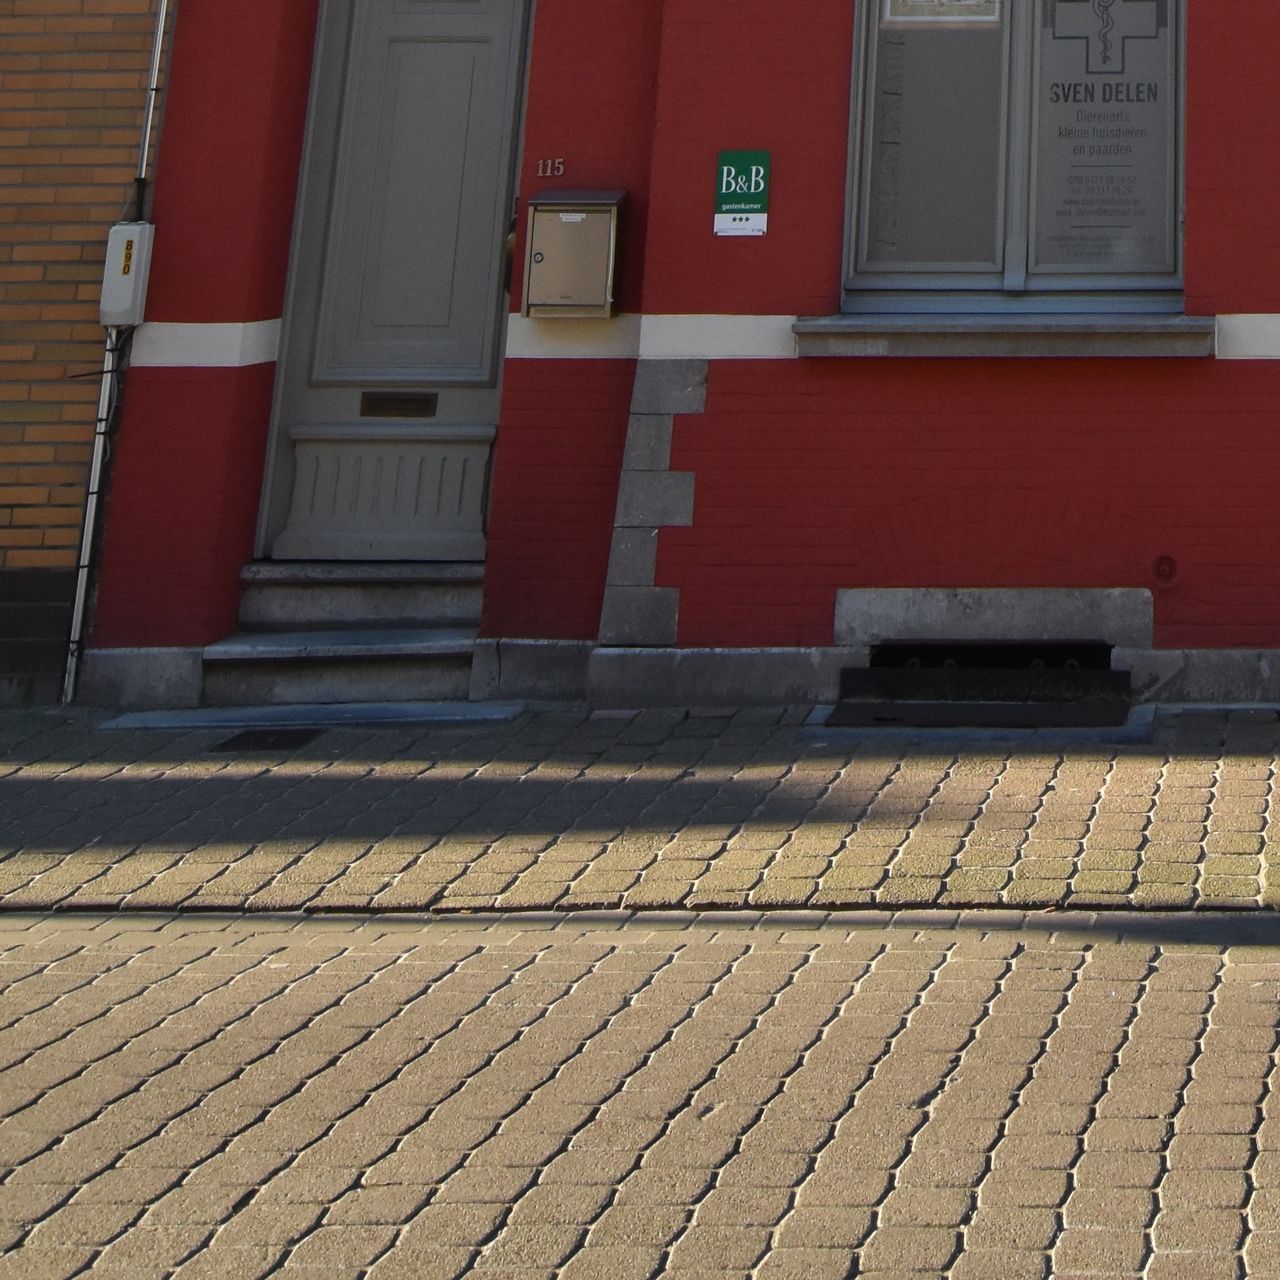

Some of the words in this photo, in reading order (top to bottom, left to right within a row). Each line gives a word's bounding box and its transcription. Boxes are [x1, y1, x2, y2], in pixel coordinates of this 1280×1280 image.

[1049, 82, 1095, 104] SVEN
[1102, 82, 1159, 104] DELEN
[1076, 110, 1130, 123] Dierenarts
[1058, 126, 1089, 139] kleine
[1092, 126, 1147, 139] huisdieren
[1072, 146, 1085, 155] en
[1089, 143, 1132, 157] paarden
[536, 158, 564, 177] 115
[720, 165, 765, 193] B&B
[721, 202, 762, 211] gastenkamer
[122, 240, 133, 275] 890
